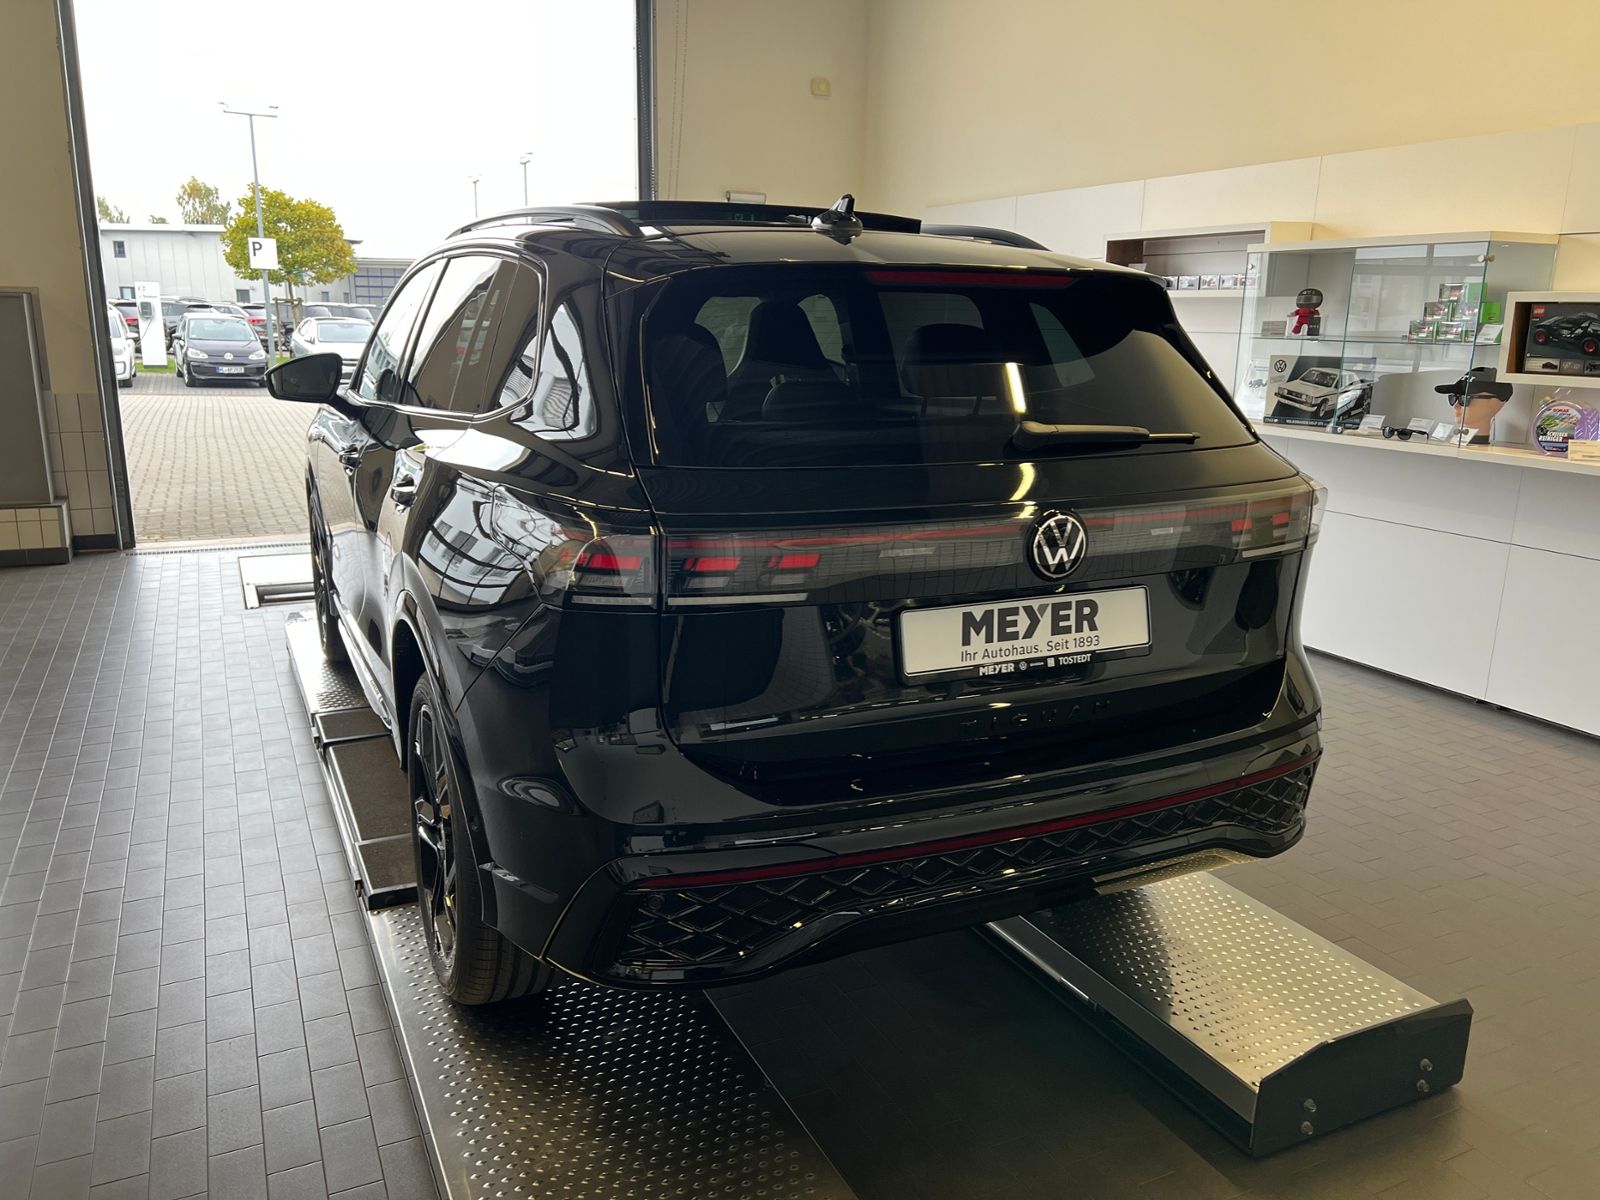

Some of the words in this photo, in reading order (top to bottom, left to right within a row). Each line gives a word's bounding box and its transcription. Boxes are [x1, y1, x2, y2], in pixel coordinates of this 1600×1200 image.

[251, 241, 263, 257] P
[961, 598, 1099, 647] MEYER
[960, 650, 978, 662] Ihr
[981, 642, 1043, 660] Autohaus.
[1046, 638, 1069, 652] Seit
[1073, 635, 1100, 649] 1893
[979, 663, 1015, 676] MEYER
[1058, 653, 1092, 665] TOSTEDT
